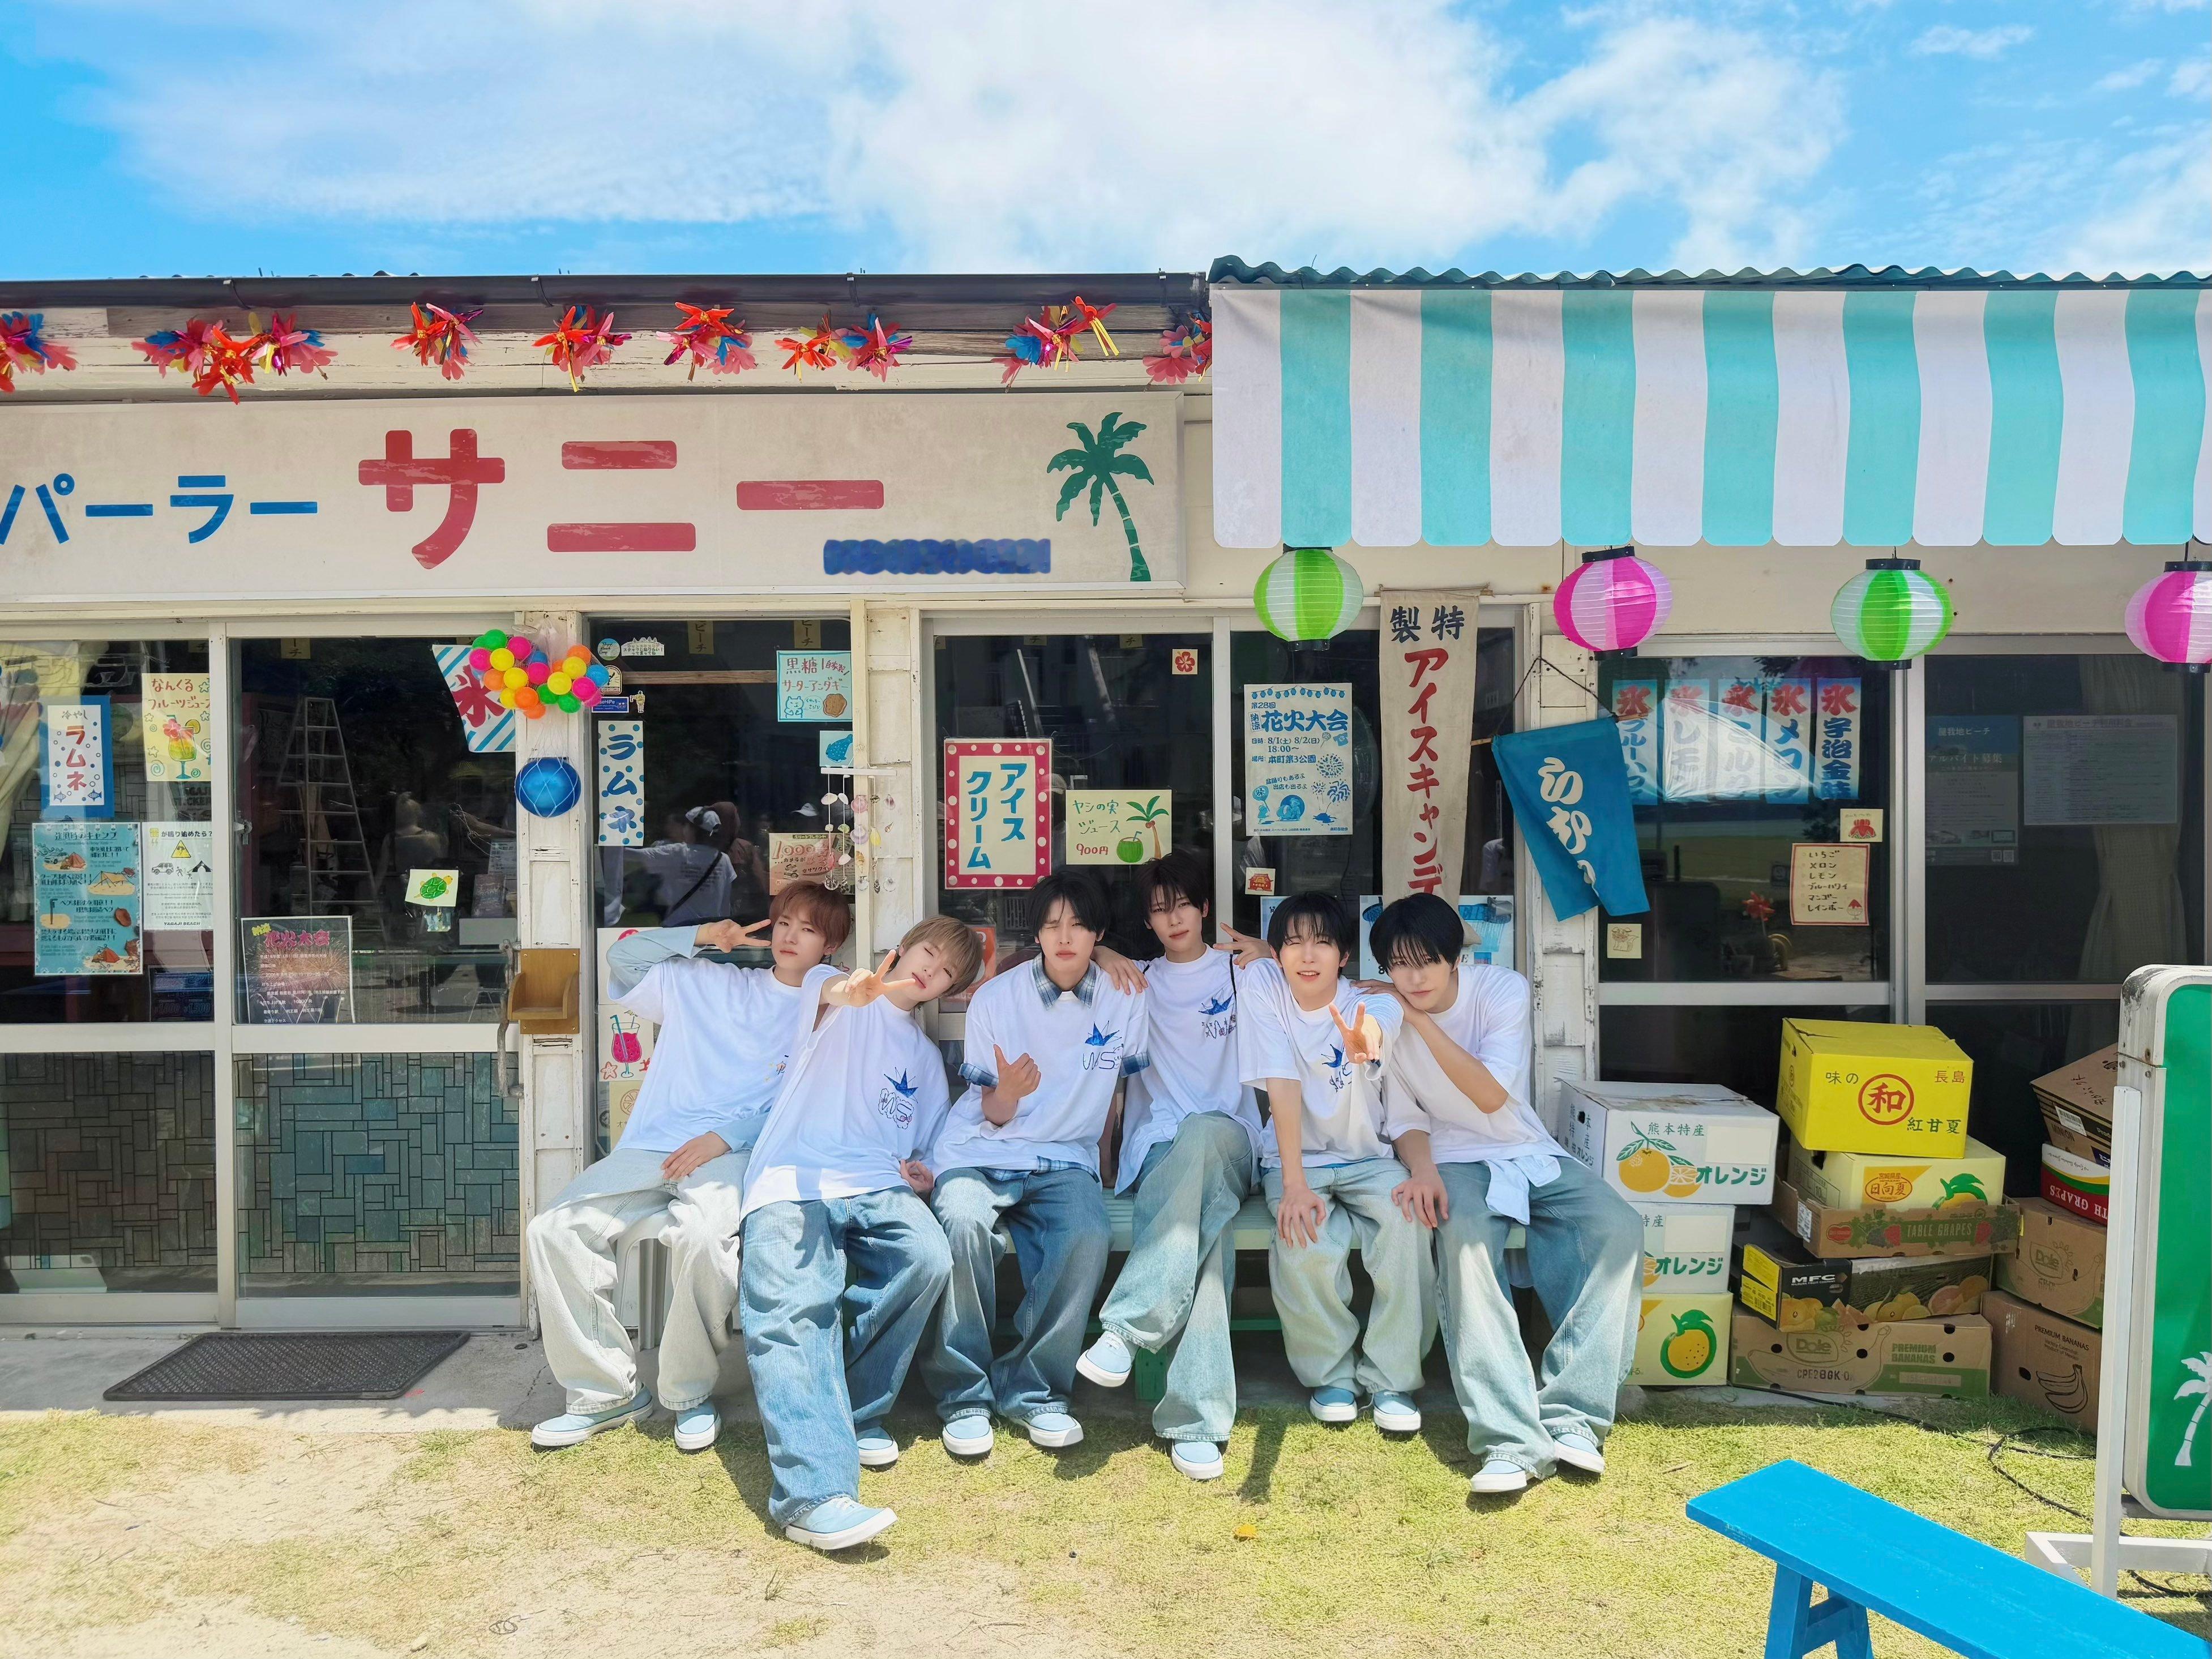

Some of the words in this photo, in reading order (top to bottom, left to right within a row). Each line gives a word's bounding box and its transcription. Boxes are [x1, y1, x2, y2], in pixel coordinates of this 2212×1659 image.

[0, 473, 318, 545] パーラー
[358, 429, 884, 570] サニー
[786, 657, 817, 674] 黒糖
[151, 678, 194, 692] なんくる
[782, 677, 849, 692] サーターアンダギー
[452, 665, 506, 728] 氷
[1771, 684, 1807, 716] 氷
[1821, 683, 1858, 716] 氷
[62, 709, 88, 720] 冷やし
[1261, 709, 1349, 733] 花火大会
[66, 725, 87, 791] ラムネ
[1268, 755, 1316, 764] 本町第3公園
[607, 734, 637, 833] ラムネ
[1000, 763, 1028, 842] アイス
[1072, 799, 1119, 815] ヤシの実
[966, 771, 992, 869] クリーム
[1078, 819, 1120, 835] ジュース
[1076, 843, 1109, 856] 900円
[1809, 850, 1840, 858] いちご
[1808, 901, 1844, 912] レインボー
[263, 929, 331, 948] 花火大会
[1825, 1071, 1859, 1085] 味の
[1934, 1070, 1966, 1084] 長島
[1867, 1082, 1907, 1114] 和
[1647, 1122, 1705, 1137] 熊本特産
[1907, 1117, 1962, 1134] 紅甘夏
[1695, 1165, 1767, 1186] オレンジ
[1870, 1181, 1908, 1196] 日向夏
[2049, 1184, 2089, 1211] GRAPES
[1907, 1224, 1933, 1238] TABLE
[1938, 1222, 1972, 1237] GRAPES
[1654, 1256, 1723, 1275] オレンジ
[2035, 1249, 2060, 1266] Dole
[1791, 1274, 1836, 1284] MFC
[1795, 1338, 1832, 1352] Dole
[2034, 1324, 2061, 1341] PREMIUM
[2061, 1335, 2090, 1351] BANANAS
[1892, 1344, 1937, 1354] PREMIUM
[1891, 1354, 1936, 1364] BANANAS
